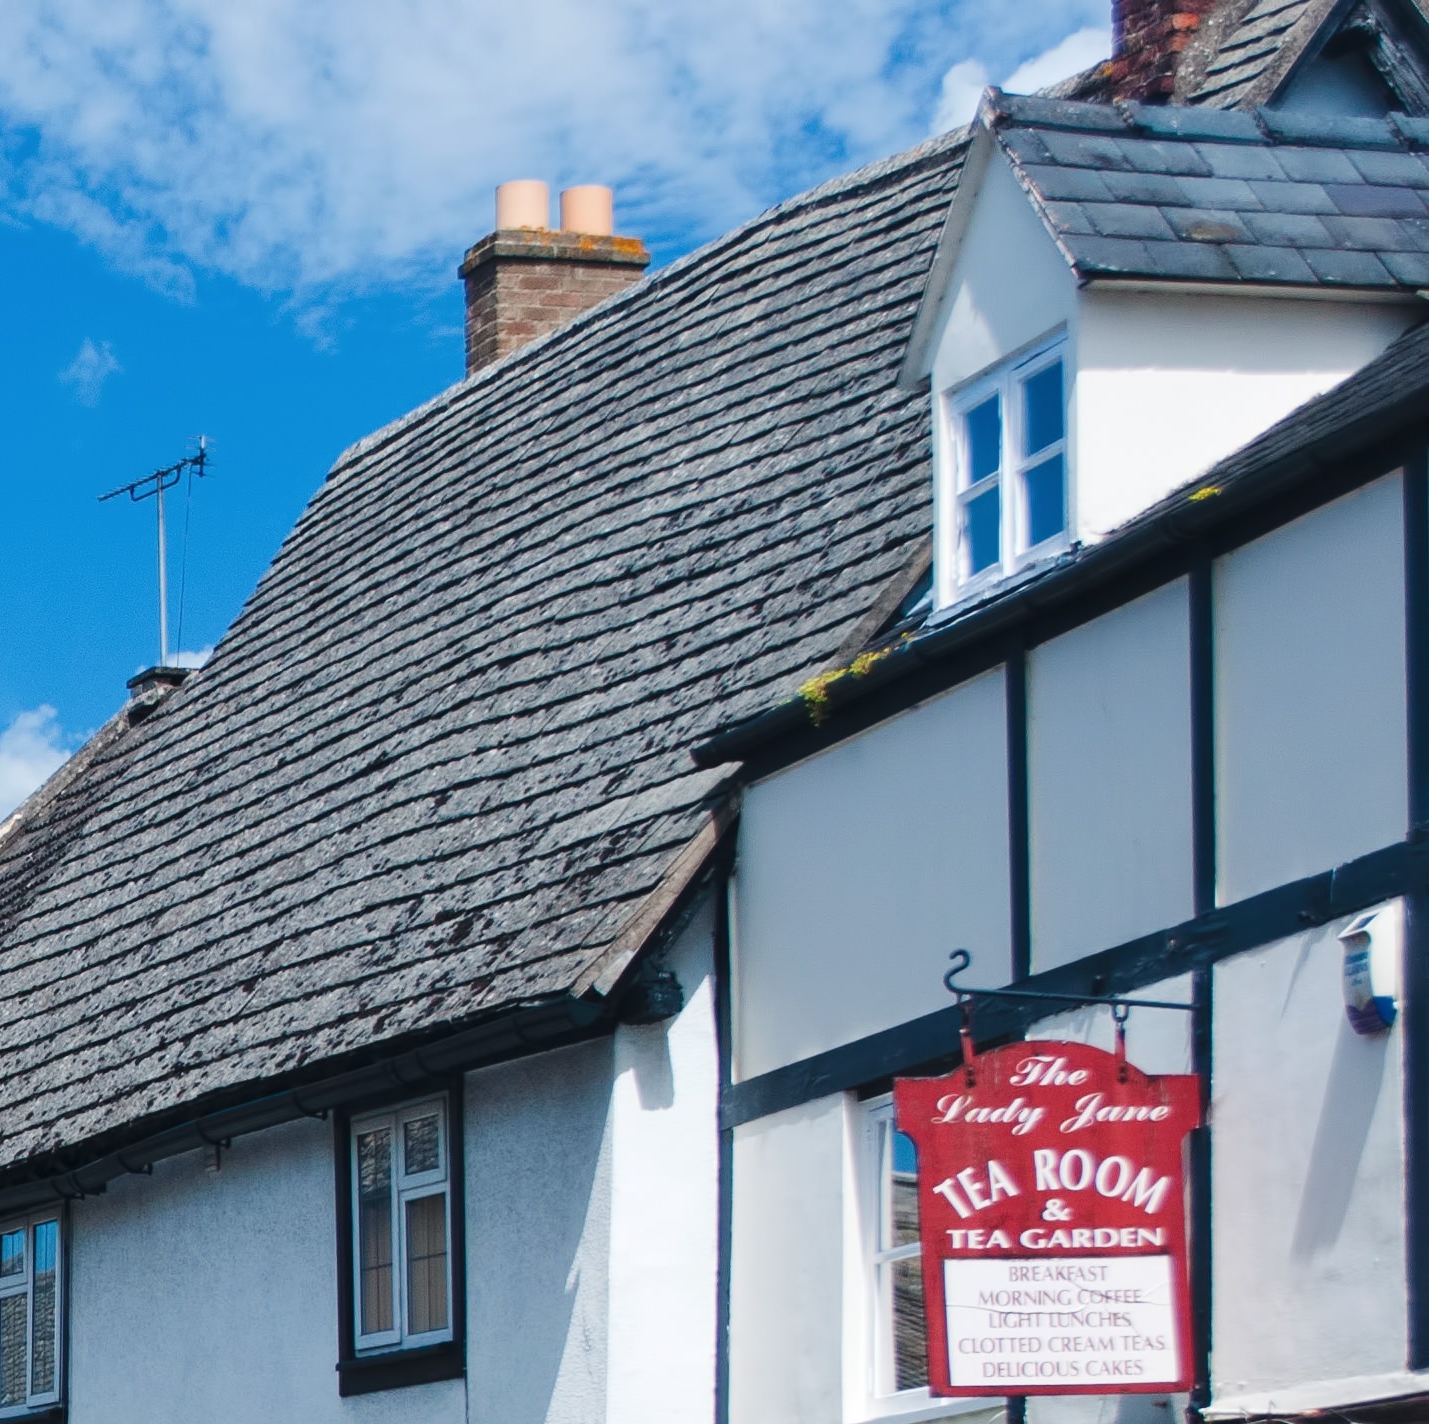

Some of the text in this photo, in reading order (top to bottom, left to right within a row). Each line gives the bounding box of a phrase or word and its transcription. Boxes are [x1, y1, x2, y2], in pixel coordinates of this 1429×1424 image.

[1009, 1055, 1090, 1087] The
[931, 1091, 1173, 1136] Lady Jane
[932, 1148, 1172, 1219] TEA ROOM
[1041, 1198, 1073, 1222] &
[946, 1226, 1165, 1250] TEA GARDEN
[1008, 1265, 1108, 1283] BREAKFAST
[978, 1288, 1142, 1307] MORNING COFFEE
[988, 1311, 1132, 1330] LIGHT LUNCHES
[958, 1335, 1166, 1355] CLOTTED CREAM TEAS
[982, 1359, 1145, 1379] DELICIOUS CAKES
